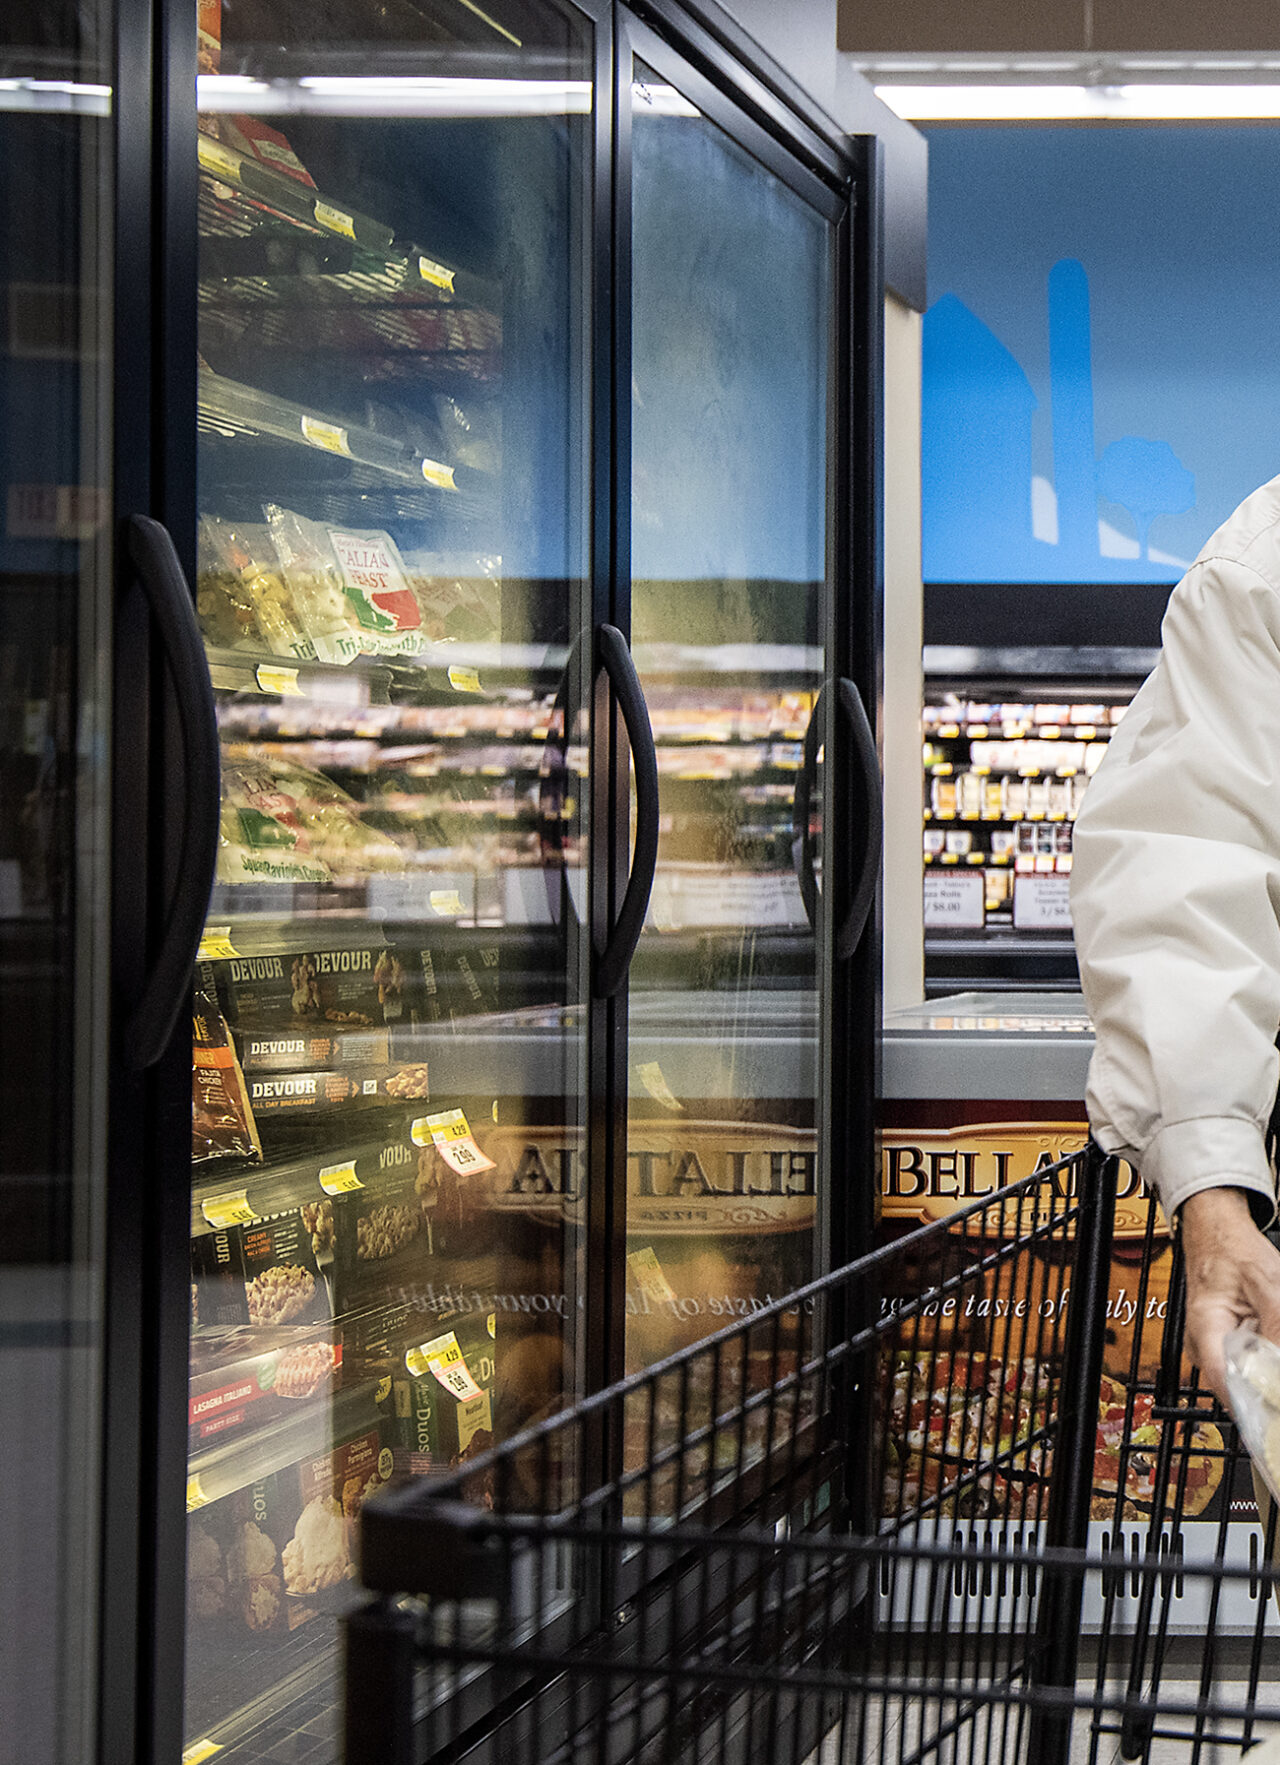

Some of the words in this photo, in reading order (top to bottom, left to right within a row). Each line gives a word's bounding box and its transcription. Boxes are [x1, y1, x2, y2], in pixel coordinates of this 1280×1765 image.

[230, 957, 284, 982] DEVOUR
[251, 1039, 305, 1055] DEVOUR
[252, 1079, 317, 1098] DEVOUR
[452, 1149, 477, 1165] 2.99
[416, 1407, 431, 1453] Duos
